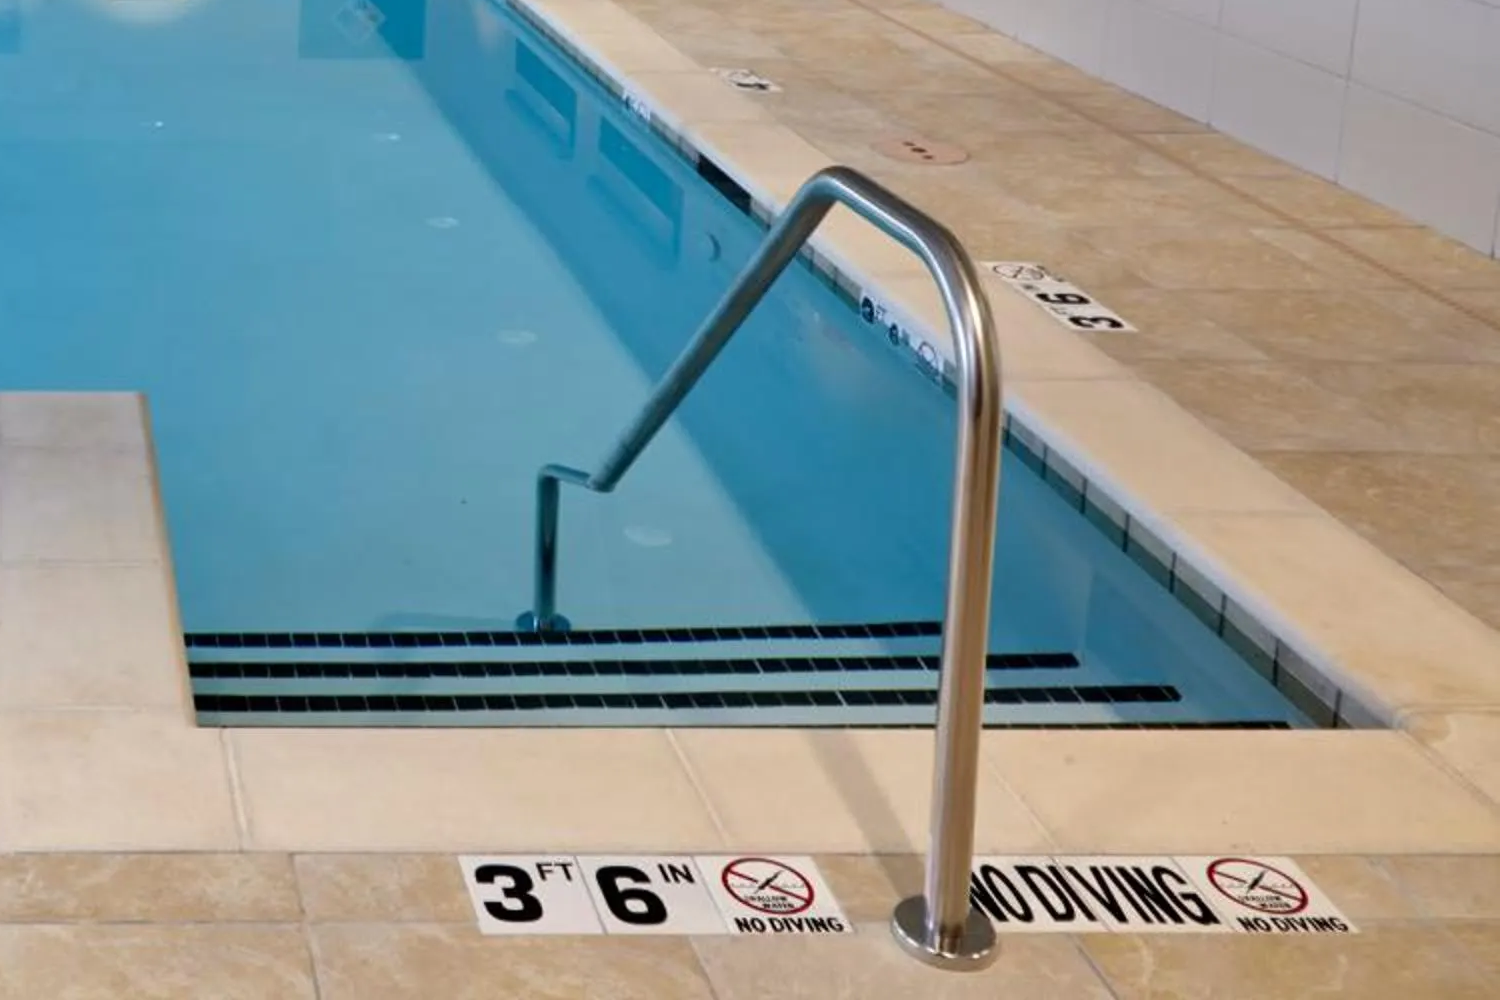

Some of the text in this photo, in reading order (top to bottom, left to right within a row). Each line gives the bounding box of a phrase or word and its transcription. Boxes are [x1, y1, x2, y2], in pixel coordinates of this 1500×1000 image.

[474, 861, 696, 925] 3 FT 6 IN
[1014, 864, 1220, 925] DIVING
[734, 917, 845, 933] NO DIVING
[1236, 916, 1349, 932] NO DIVING
